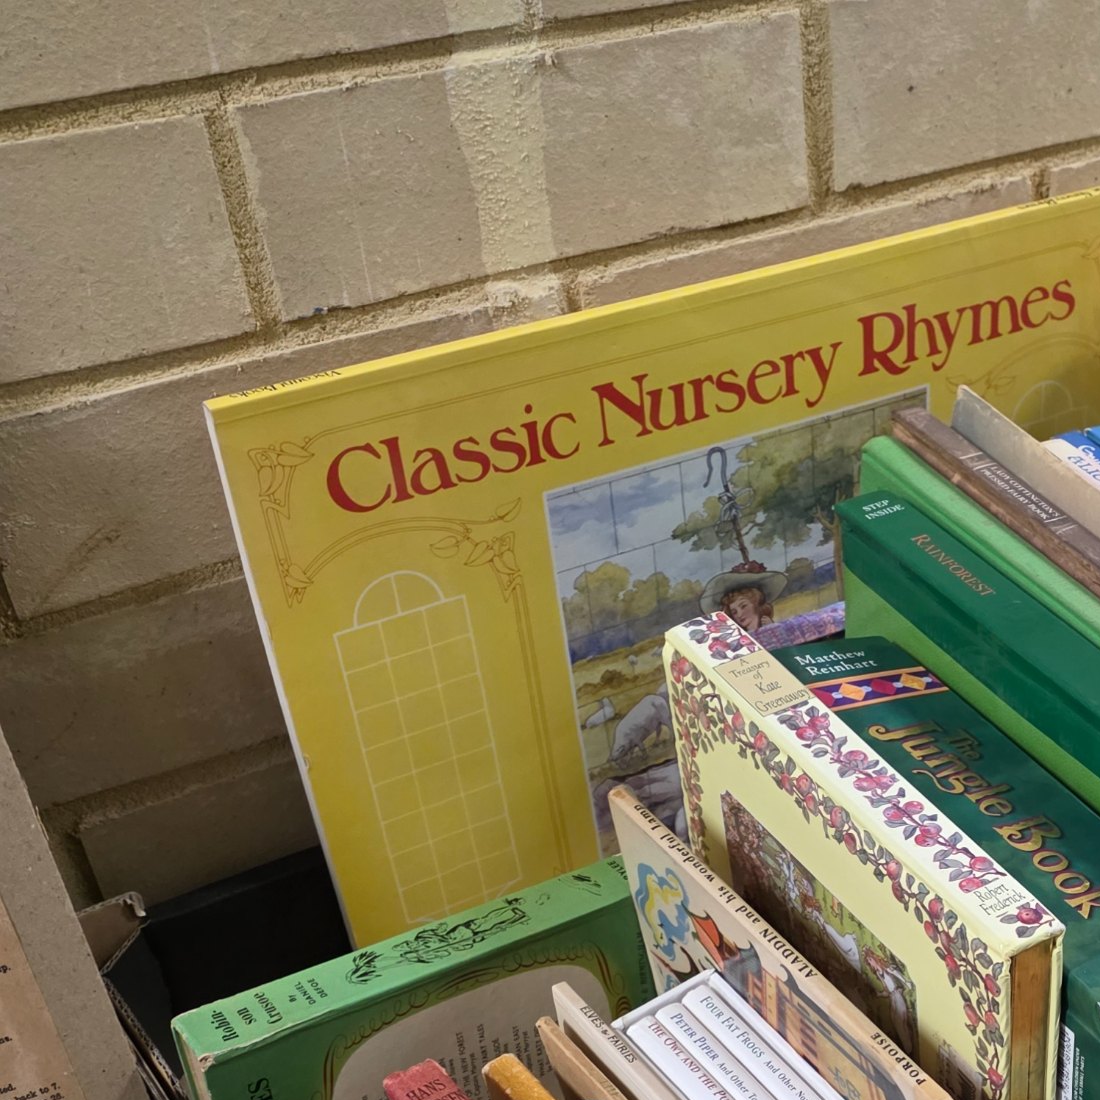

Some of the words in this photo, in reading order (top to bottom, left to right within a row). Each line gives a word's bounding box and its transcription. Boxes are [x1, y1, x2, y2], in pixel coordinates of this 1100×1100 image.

[326, 404, 581, 515] Classic
[591, 341, 843, 448] Nursery
[856, 279, 1077, 377] Rhymes
[861, 498, 890, 513] STEP
[864, 503, 905, 521] INSIDE
[1026, 501, 1051, 520] BOOK
[910, 532, 997, 598] RAINFOREST
[728, 658, 771, 680] Treasury
[793, 648, 867, 667] Matthew
[804, 657, 879, 678] Reinhart
[753, 688, 812, 714] Greenaway
[756, 678, 783, 697] Kate
[866, 719, 1016, 819] Jungle
[632, 802, 660, 832] Lamp
[658, 833, 716, 885] wonderful
[717, 884, 737, 906] his
[973, 882, 1011, 903] Robert
[978, 889, 1027, 917] Frederick
[734, 904, 762, 927] and
[758, 925, 819, 979] ALADDIN
[294, 981, 317, 1006] DANIEL
[306, 976, 330, 1000] DEFOE
[236, 1006, 258, 1024] son
[253, 990, 285, 1026] Crusoe
[211, 1008, 240, 1044] Robin-
[579, 1005, 603, 1029] ELVES
[606, 1033, 639, 1065] FAIRIES
[647, 1021, 666, 1040] THE
[663, 1035, 684, 1059] OWL
[681, 1055, 701, 1075] AND
[697, 1071, 717, 1091] THE
[669, 1012, 695, 1038] PETER
[694, 1034, 721, 1062] PIPER
[716, 1061, 732, 1076] And
[728, 1073, 750, 1096] Other
[699, 995, 723, 1018] FOUR
[721, 1014, 740, 1034] FAT
[735, 1029, 766, 1059] FROGS
[763, 1059, 779, 1074] And
[775, 1071, 797, 1094] Other
[869, 1030, 927, 1086] PORPOISE
